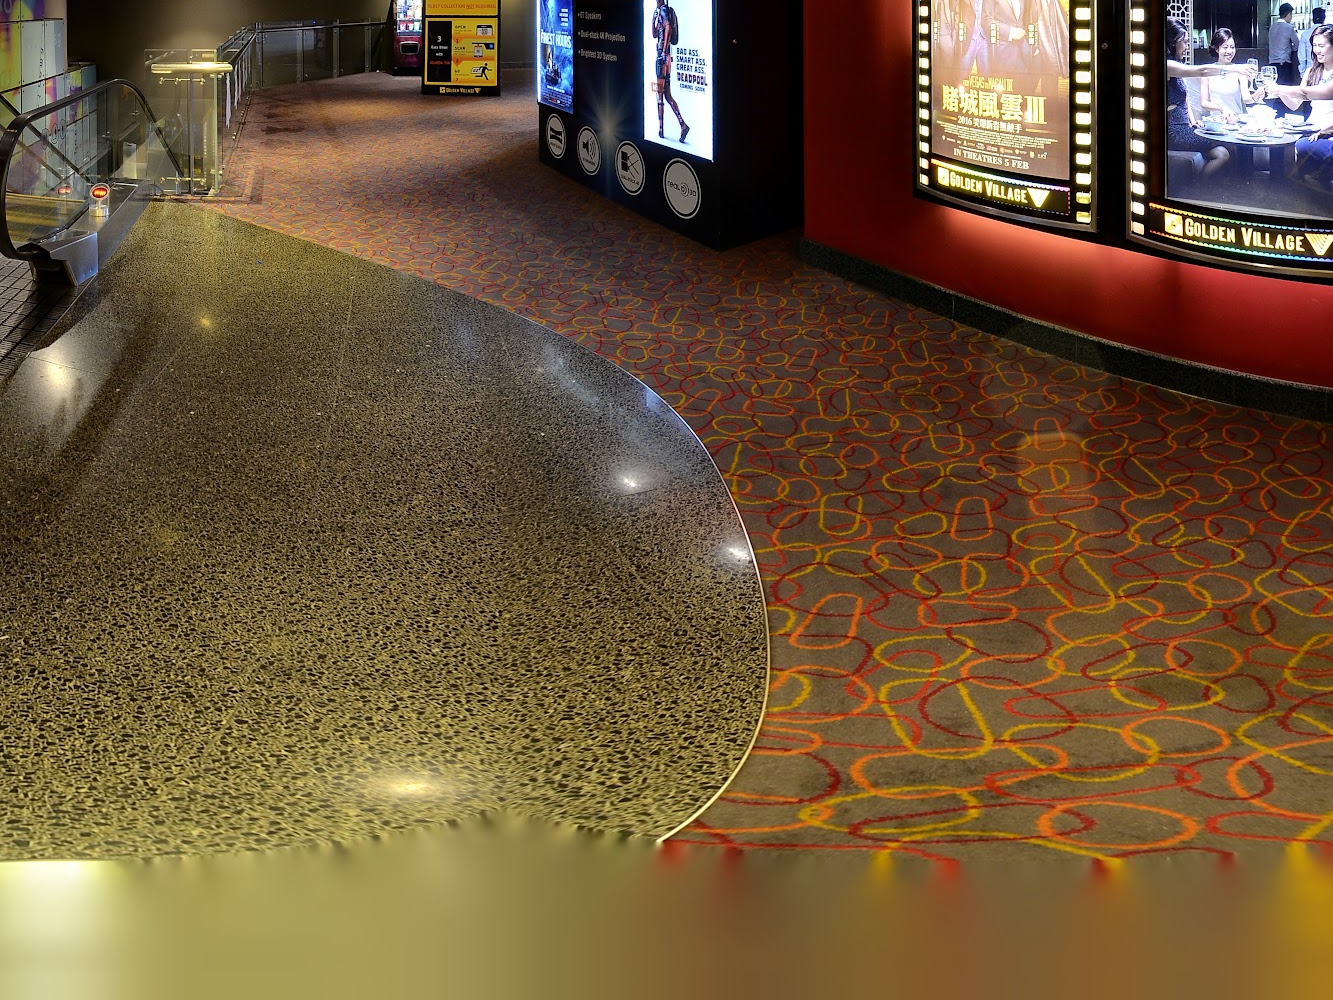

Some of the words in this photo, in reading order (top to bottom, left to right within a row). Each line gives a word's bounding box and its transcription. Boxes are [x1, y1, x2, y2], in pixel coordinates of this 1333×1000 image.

[540, 30, 555, 45] FINEST
[556, 33, 572, 48] HOURS
[677, 72, 708, 86] DEADPOOL
[954, 148, 962, 156] IN
[962, 150, 1002, 166] THEATRES
[1012, 160, 1030, 170] FEB
[950, 172, 983, 194] GOLDEN
[984, 180, 1028, 204] VILLAGE
[1184, 216, 1236, 242] GOLDEN
[1241, 226, 1306, 252] VILLAGE
